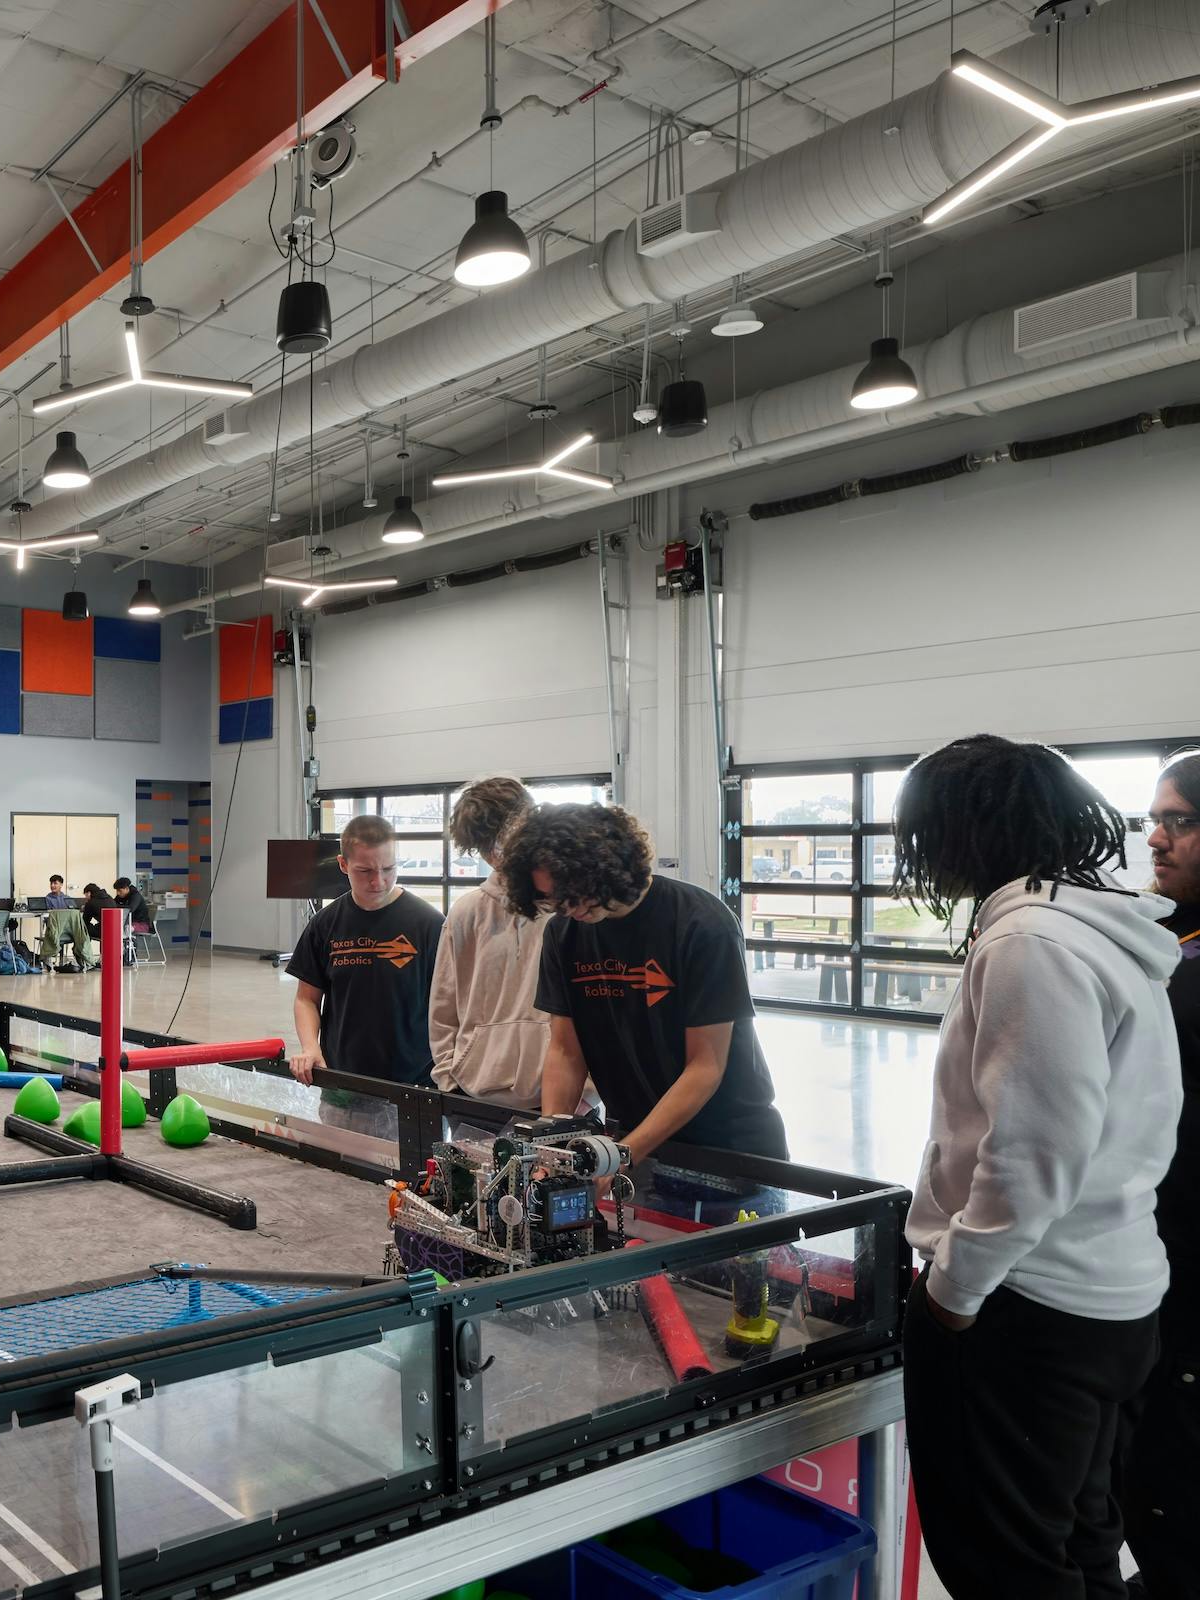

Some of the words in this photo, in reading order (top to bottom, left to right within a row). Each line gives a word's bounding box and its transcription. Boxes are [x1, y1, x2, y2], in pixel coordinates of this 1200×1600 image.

[329, 939, 354, 949] Texas
[357, 936, 377, 948] City
[332, 955, 372, 967] Robotics
[573, 961, 602, 974] Texa
[603, 958, 627, 974] City
